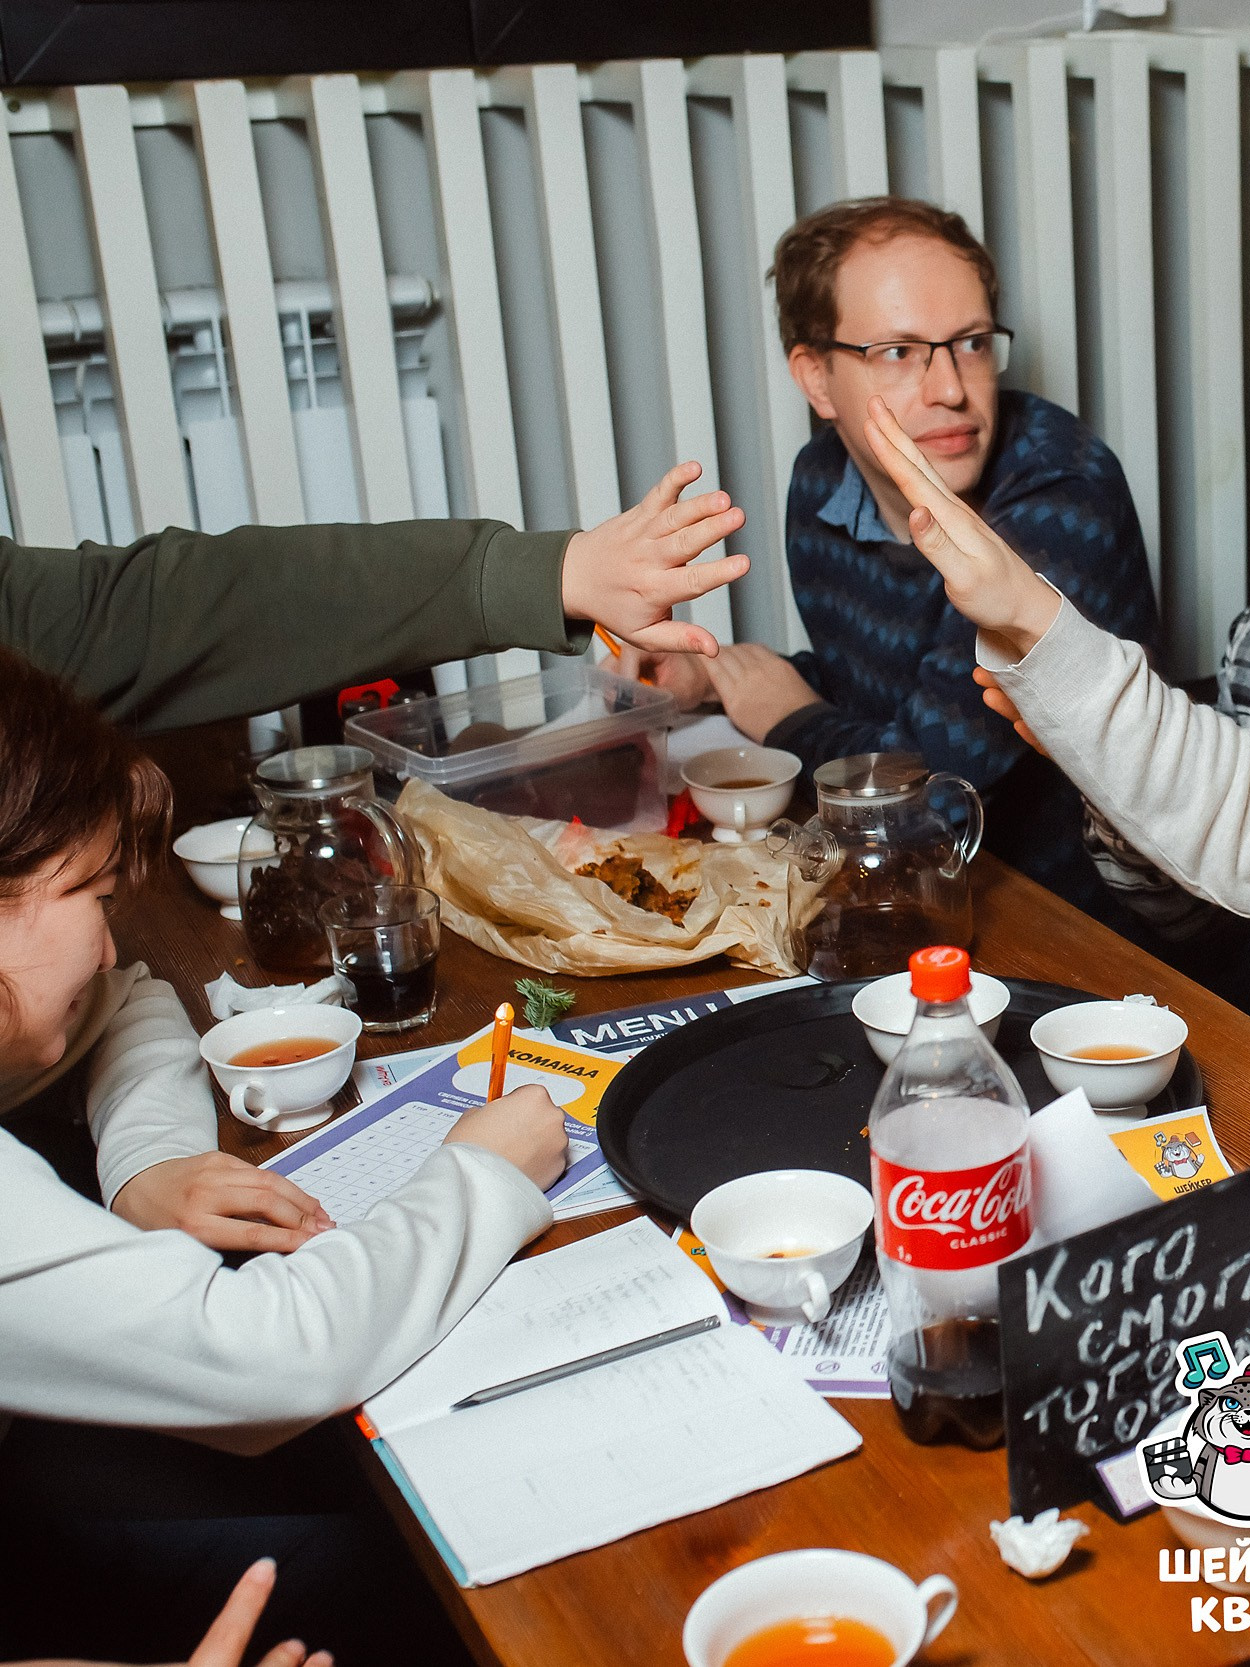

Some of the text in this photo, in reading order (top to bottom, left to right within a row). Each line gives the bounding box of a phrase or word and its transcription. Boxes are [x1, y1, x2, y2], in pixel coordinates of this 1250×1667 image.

[507, 1048, 600, 1079] КОМАНДА
[1173, 1178, 1212, 1194] ШЕЙКЕР
[950, 1227, 1008, 1250] CLASSIC
